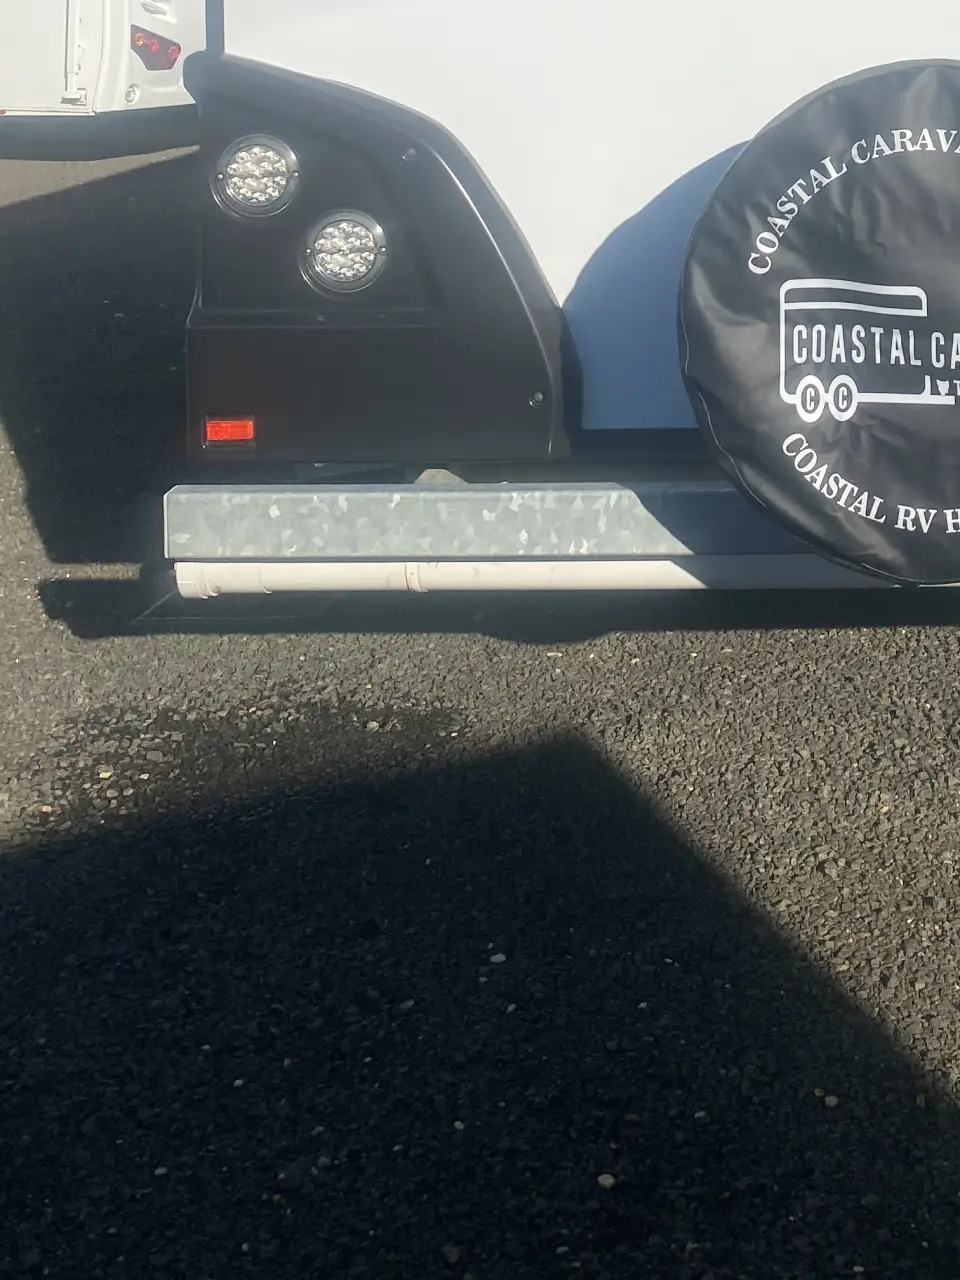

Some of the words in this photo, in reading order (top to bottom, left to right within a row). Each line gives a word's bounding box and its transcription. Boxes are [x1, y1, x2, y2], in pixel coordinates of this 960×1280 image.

[748, 156, 848, 275] COASTAL
[793, 324, 922, 366] COASTAL
[782, 433, 887, 524] COASTAL
[894, 504, 937, 534] RV
